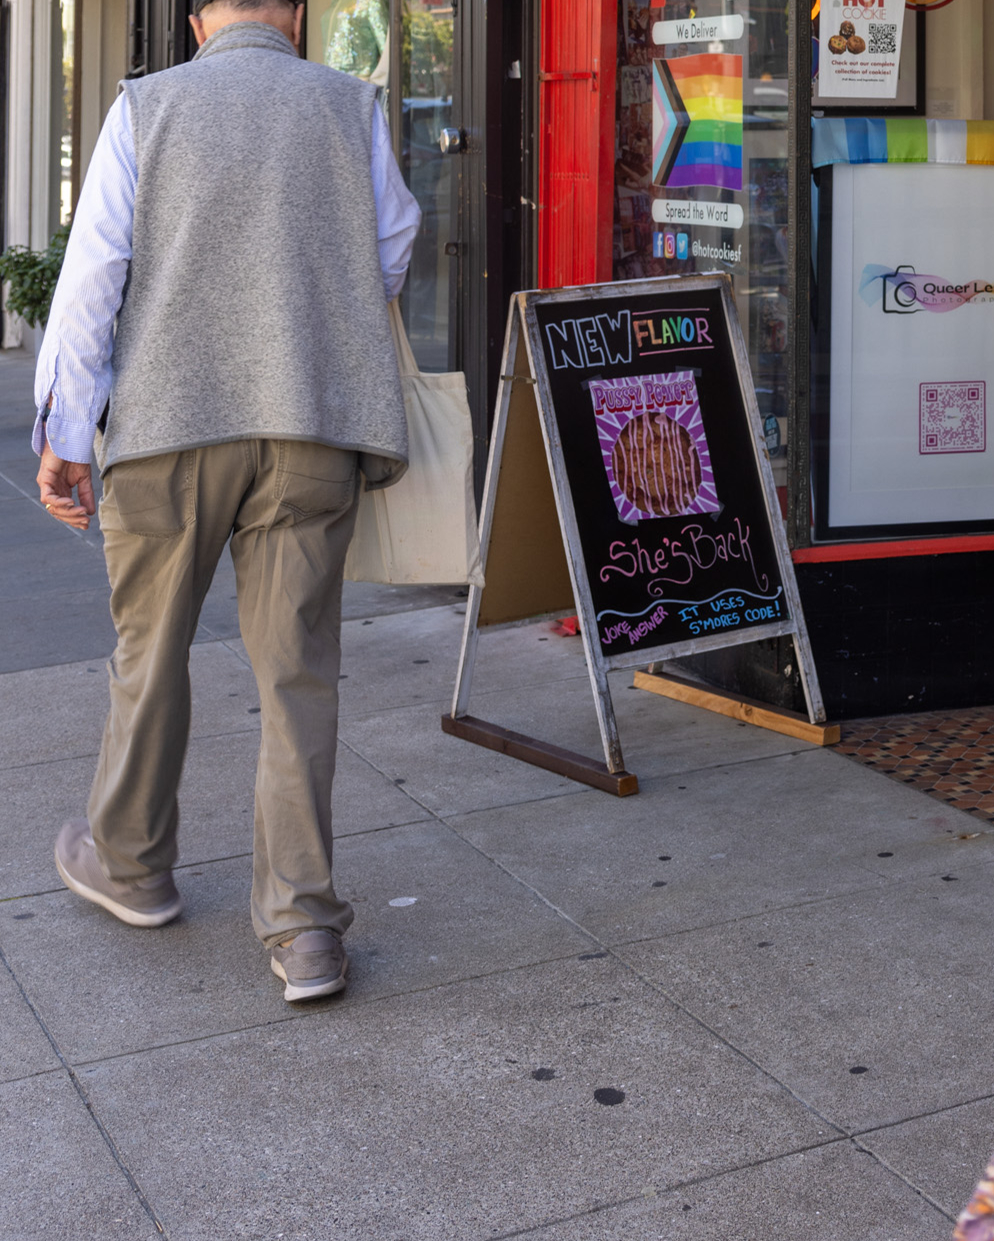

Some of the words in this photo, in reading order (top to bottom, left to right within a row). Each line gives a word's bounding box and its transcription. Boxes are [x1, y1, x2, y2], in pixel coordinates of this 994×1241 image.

[842, 7, 887, 21] COOKIE
[676, 25, 689, 39] We
[691, 22, 718, 38] Deliver
[665, 202, 690, 221] Spread
[692, 202, 704, 220] the
[706, 205, 729, 222] Word
[691, 240, 742, 262] @hotcookiesf
[923, 283, 970, 296] Queer
[545, 309, 632, 370] NEW
[632, 316, 713, 348] FLAVOR
[591, 385, 642, 415] PUSSY
[600, 537, 693, 598] She's
[680, 517, 769, 593] Back
[678, 605, 699, 622] IT
[710, 596, 745, 612] USES
[689, 612, 741, 634] S'MORES
[745, 600, 781, 623] CODE!
[601, 620, 632, 644] JOKE
[628, 605, 669, 645] ANSWER
